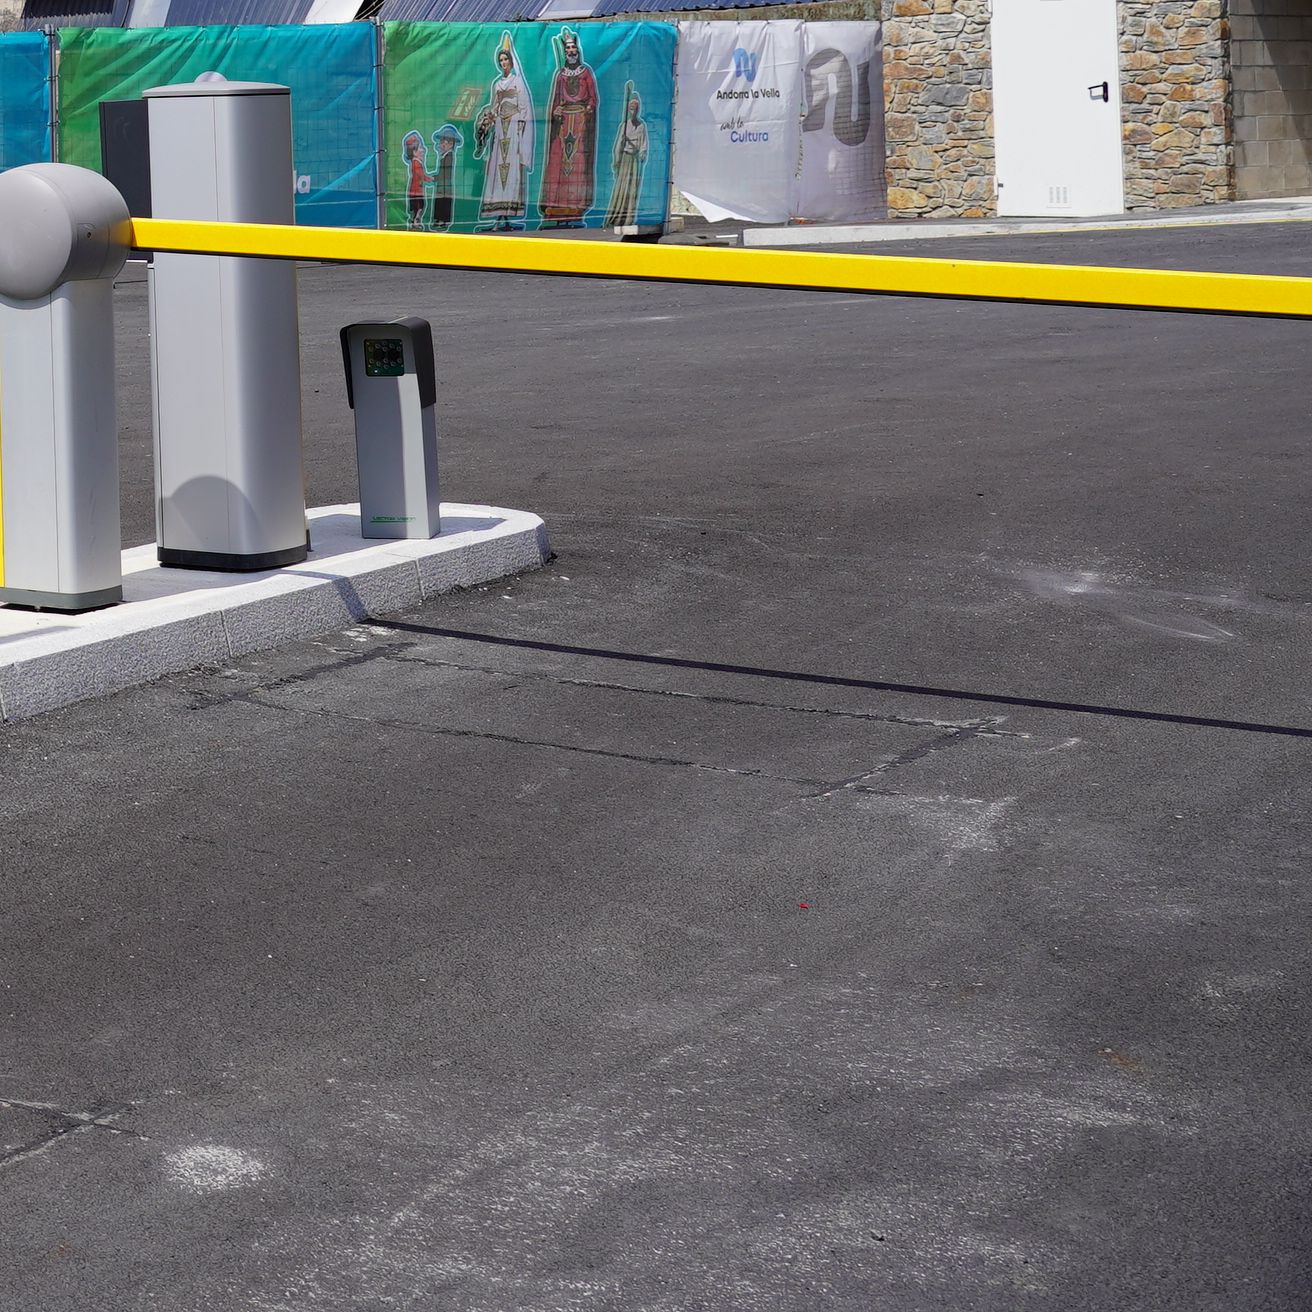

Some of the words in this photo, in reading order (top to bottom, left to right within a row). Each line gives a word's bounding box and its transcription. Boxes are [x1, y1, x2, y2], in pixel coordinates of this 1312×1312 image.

[716, 89, 750, 100] Andorra
[750, 88, 759, 99] la
[760, 87, 780, 98] Vella
[730, 130, 768, 142] Cultura
